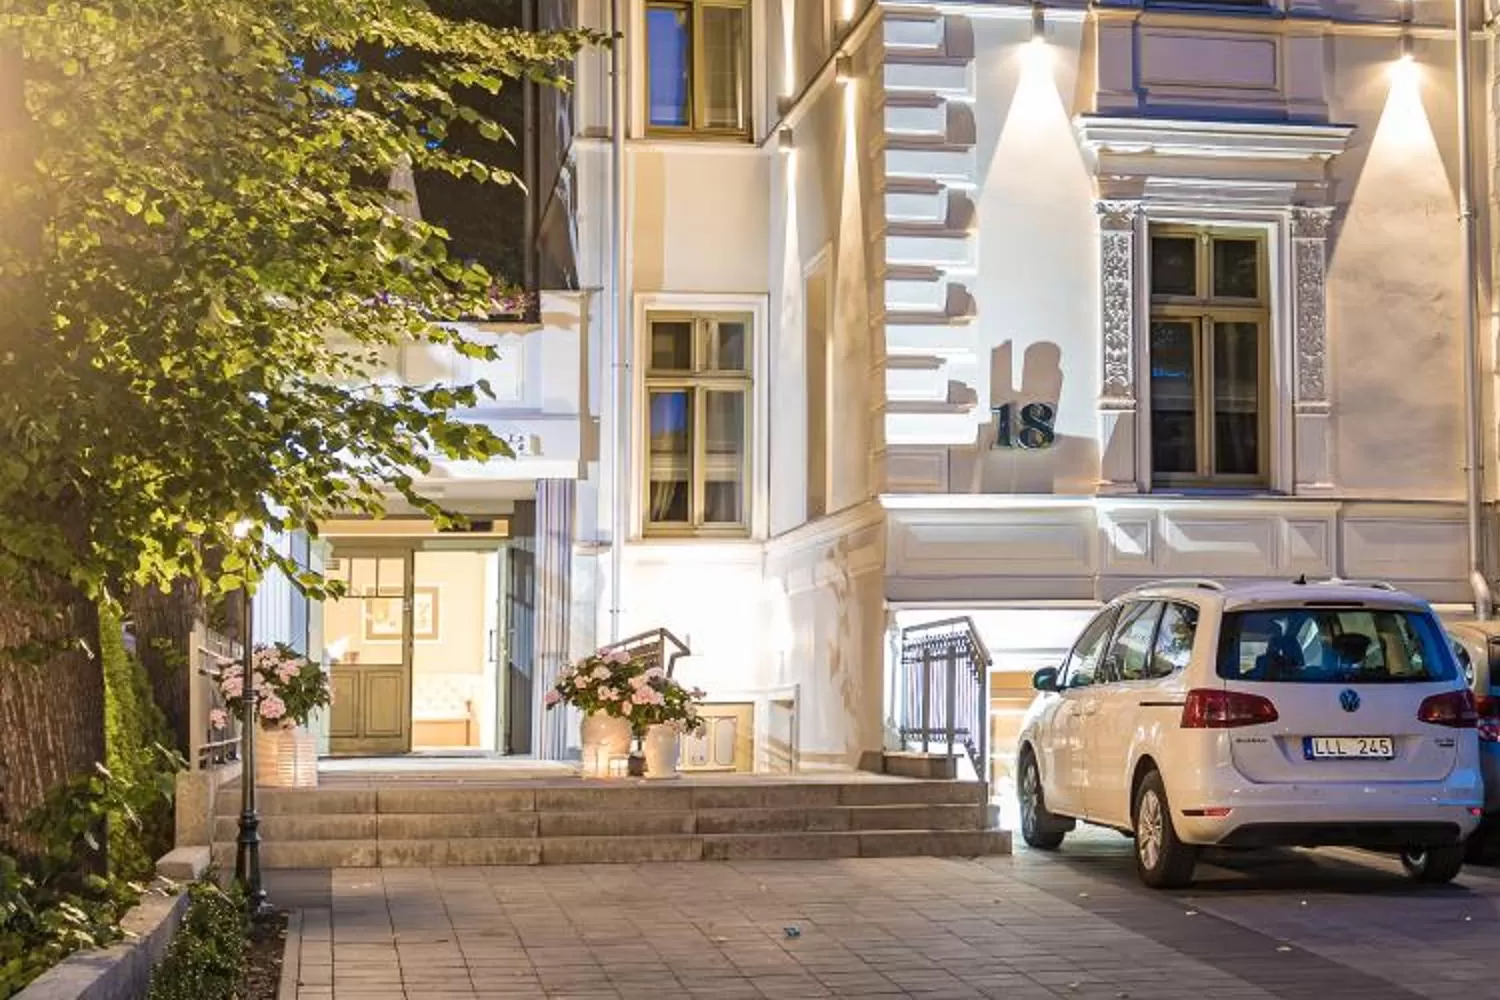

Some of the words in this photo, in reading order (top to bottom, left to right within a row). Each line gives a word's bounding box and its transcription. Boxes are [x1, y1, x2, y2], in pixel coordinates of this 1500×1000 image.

[991, 402, 1055, 449] 18
[1315, 738, 1347, 755] LLL
[1358, 738, 1389, 755] 245
